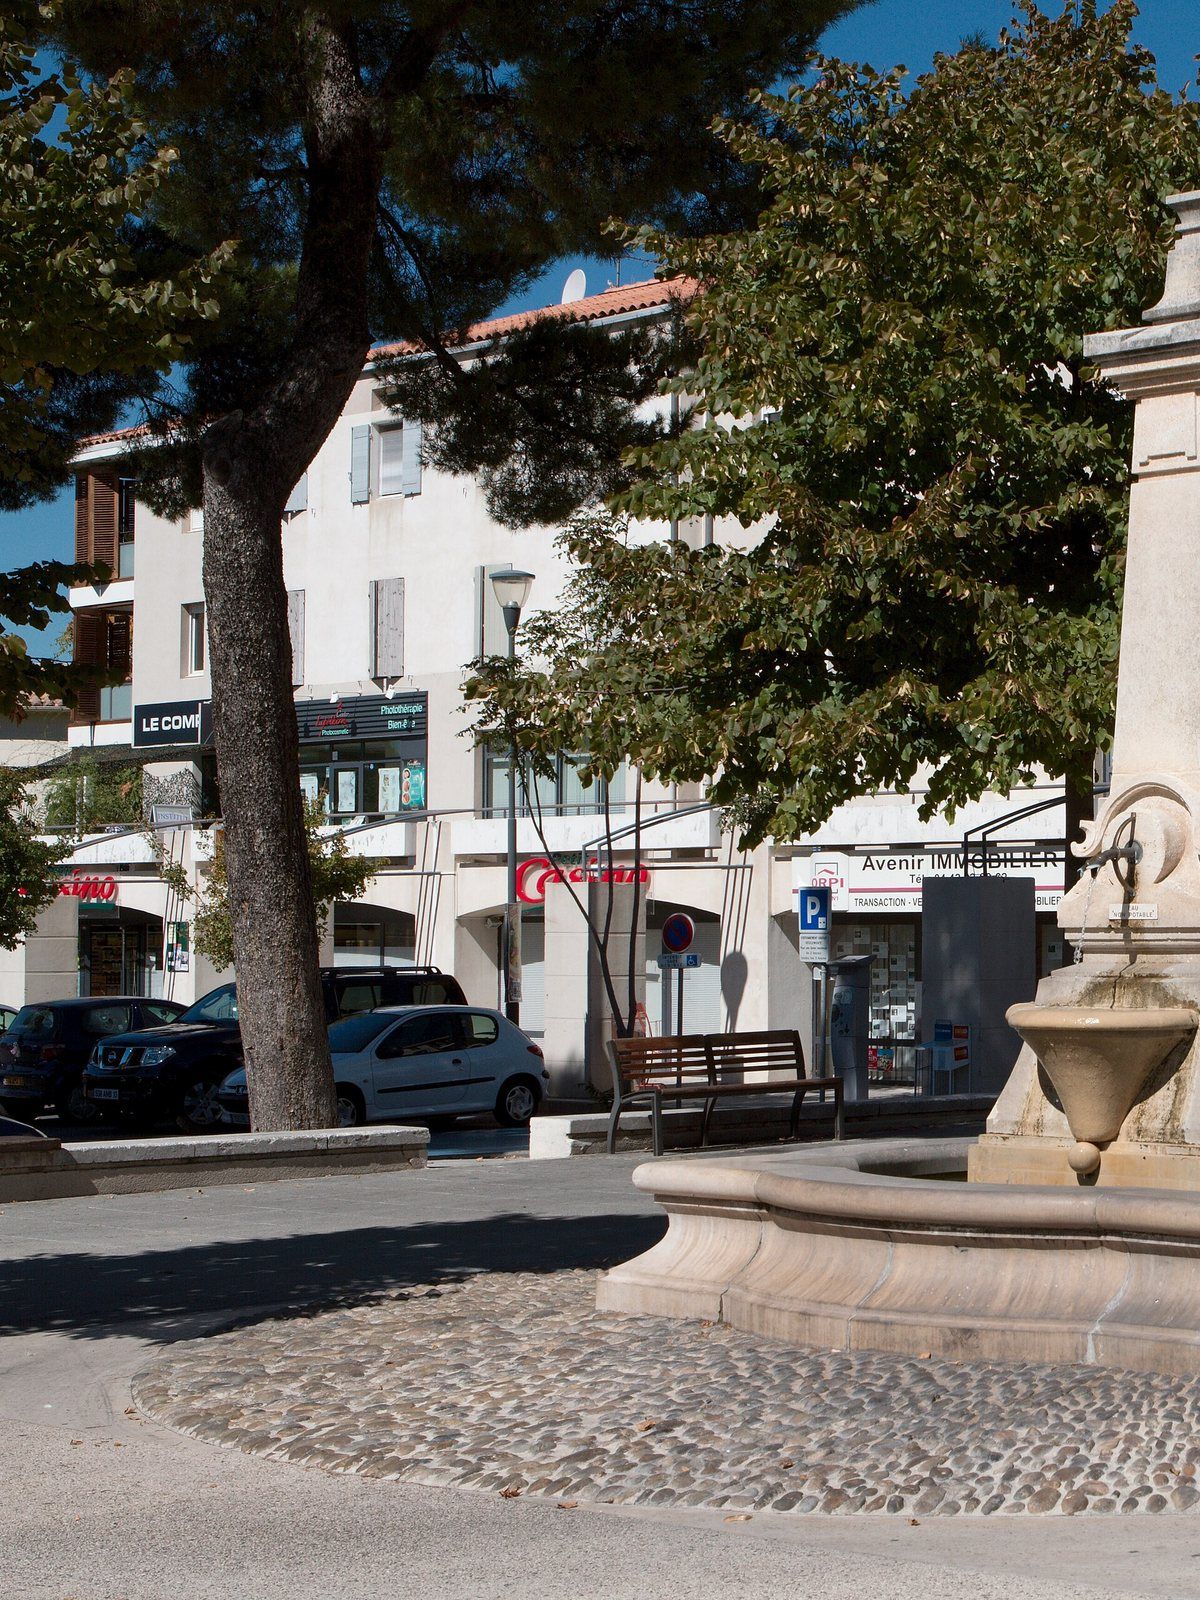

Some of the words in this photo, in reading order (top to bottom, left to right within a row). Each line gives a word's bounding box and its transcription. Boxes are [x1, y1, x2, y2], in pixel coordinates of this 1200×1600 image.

[381, 703, 423, 715] Photothérapie
[142, 717, 160, 732] LE
[388, 718, 416, 730] Bien-êe
[862, 855, 924, 871] Avenir
[931, 851, 1058, 869] IMMOBILIER
[811, 877, 845, 888] ORPI
[854, 898, 906, 907] TRANSACTION
[807, 896, 820, 924] P
